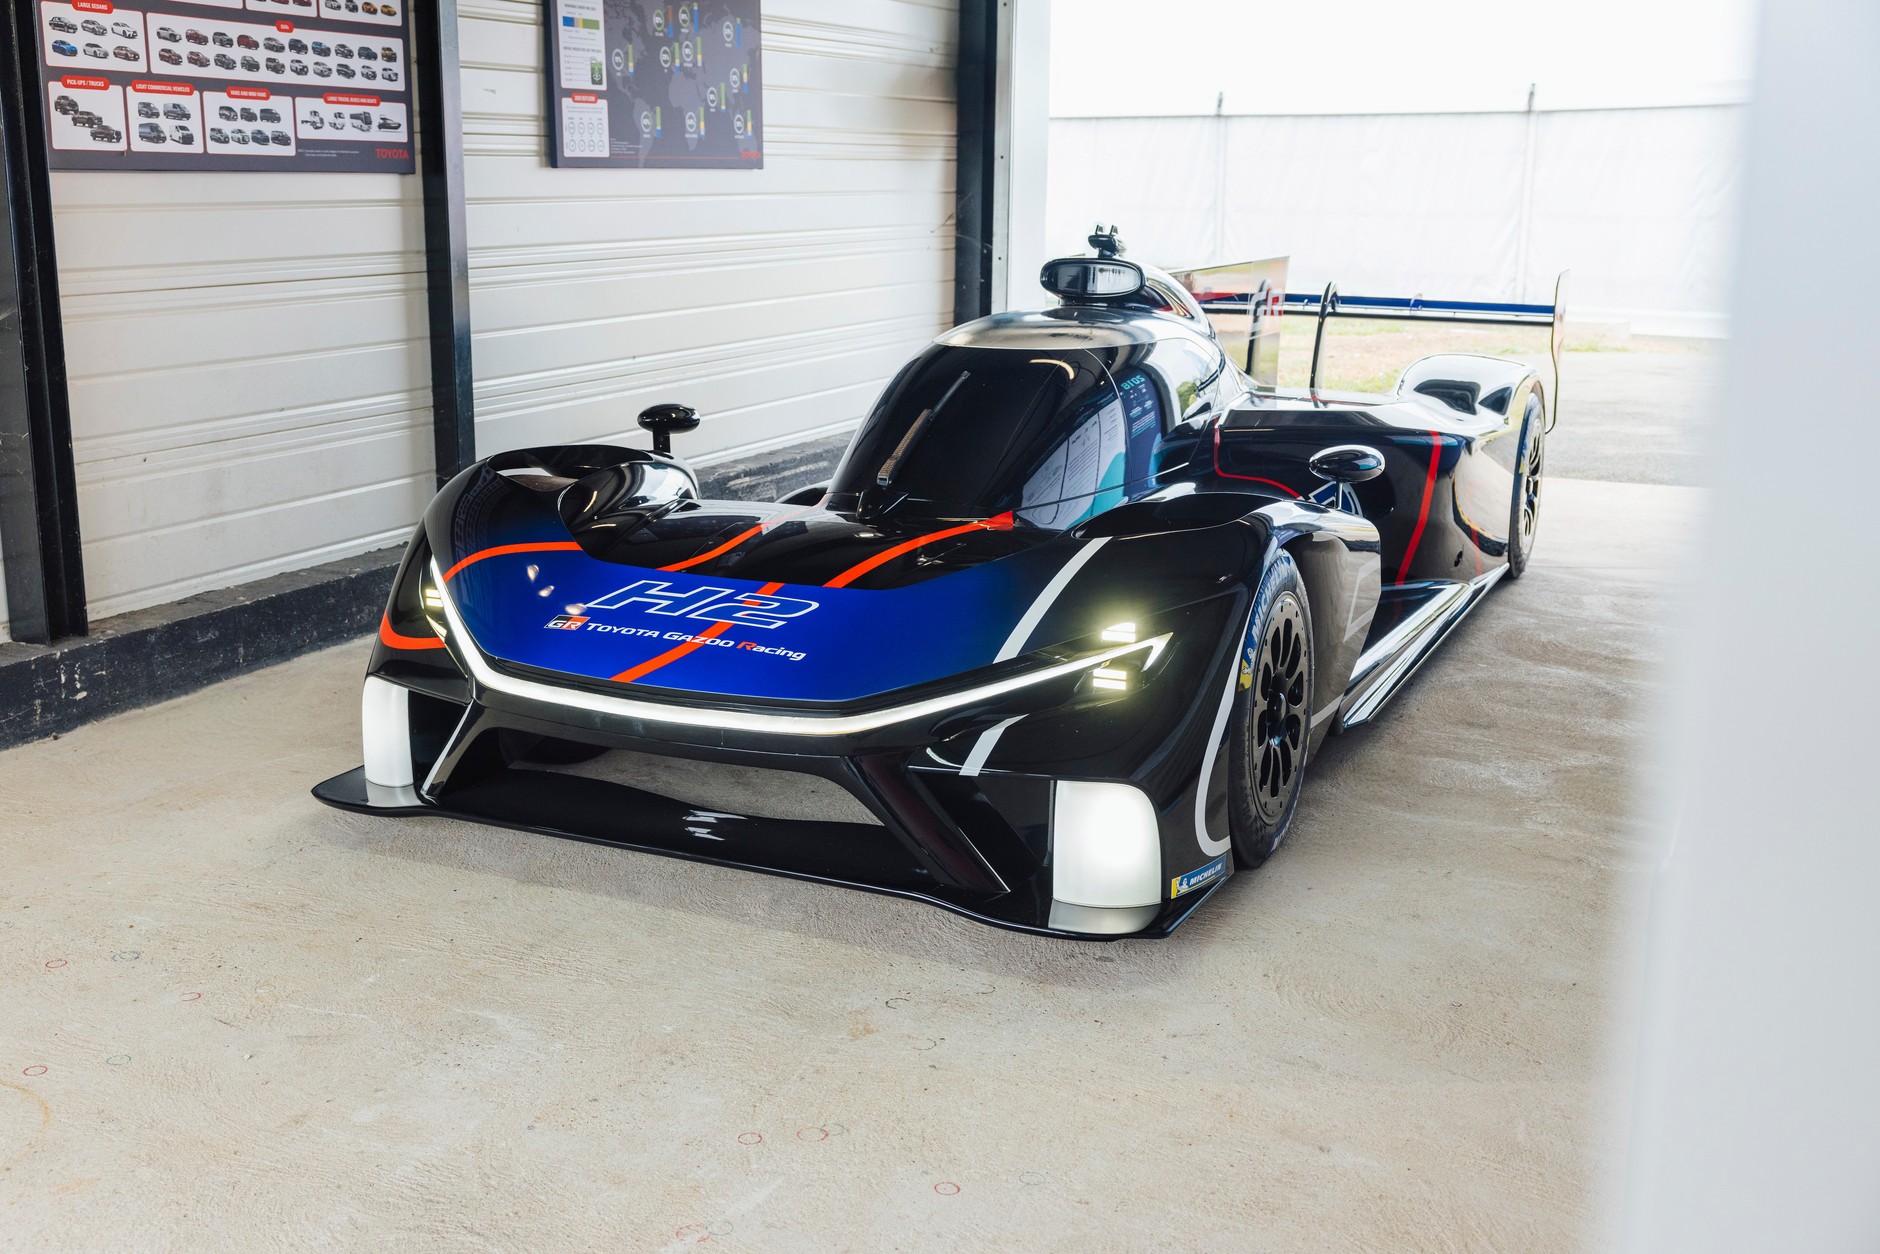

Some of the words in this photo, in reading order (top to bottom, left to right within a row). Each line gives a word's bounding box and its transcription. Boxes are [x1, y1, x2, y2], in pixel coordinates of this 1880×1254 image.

[77, 1, 91, 9] LARGE
[375, 148, 409, 159] TOYOTA
[584, 579, 819, 629] H2
[546, 619, 583, 630] GR
[587, 622, 660, 638] TOYOTA
[662, 631, 735, 647] GAZOO
[736, 641, 807, 661] Racing
[1189, 862, 1223, 886] MICHELIN
